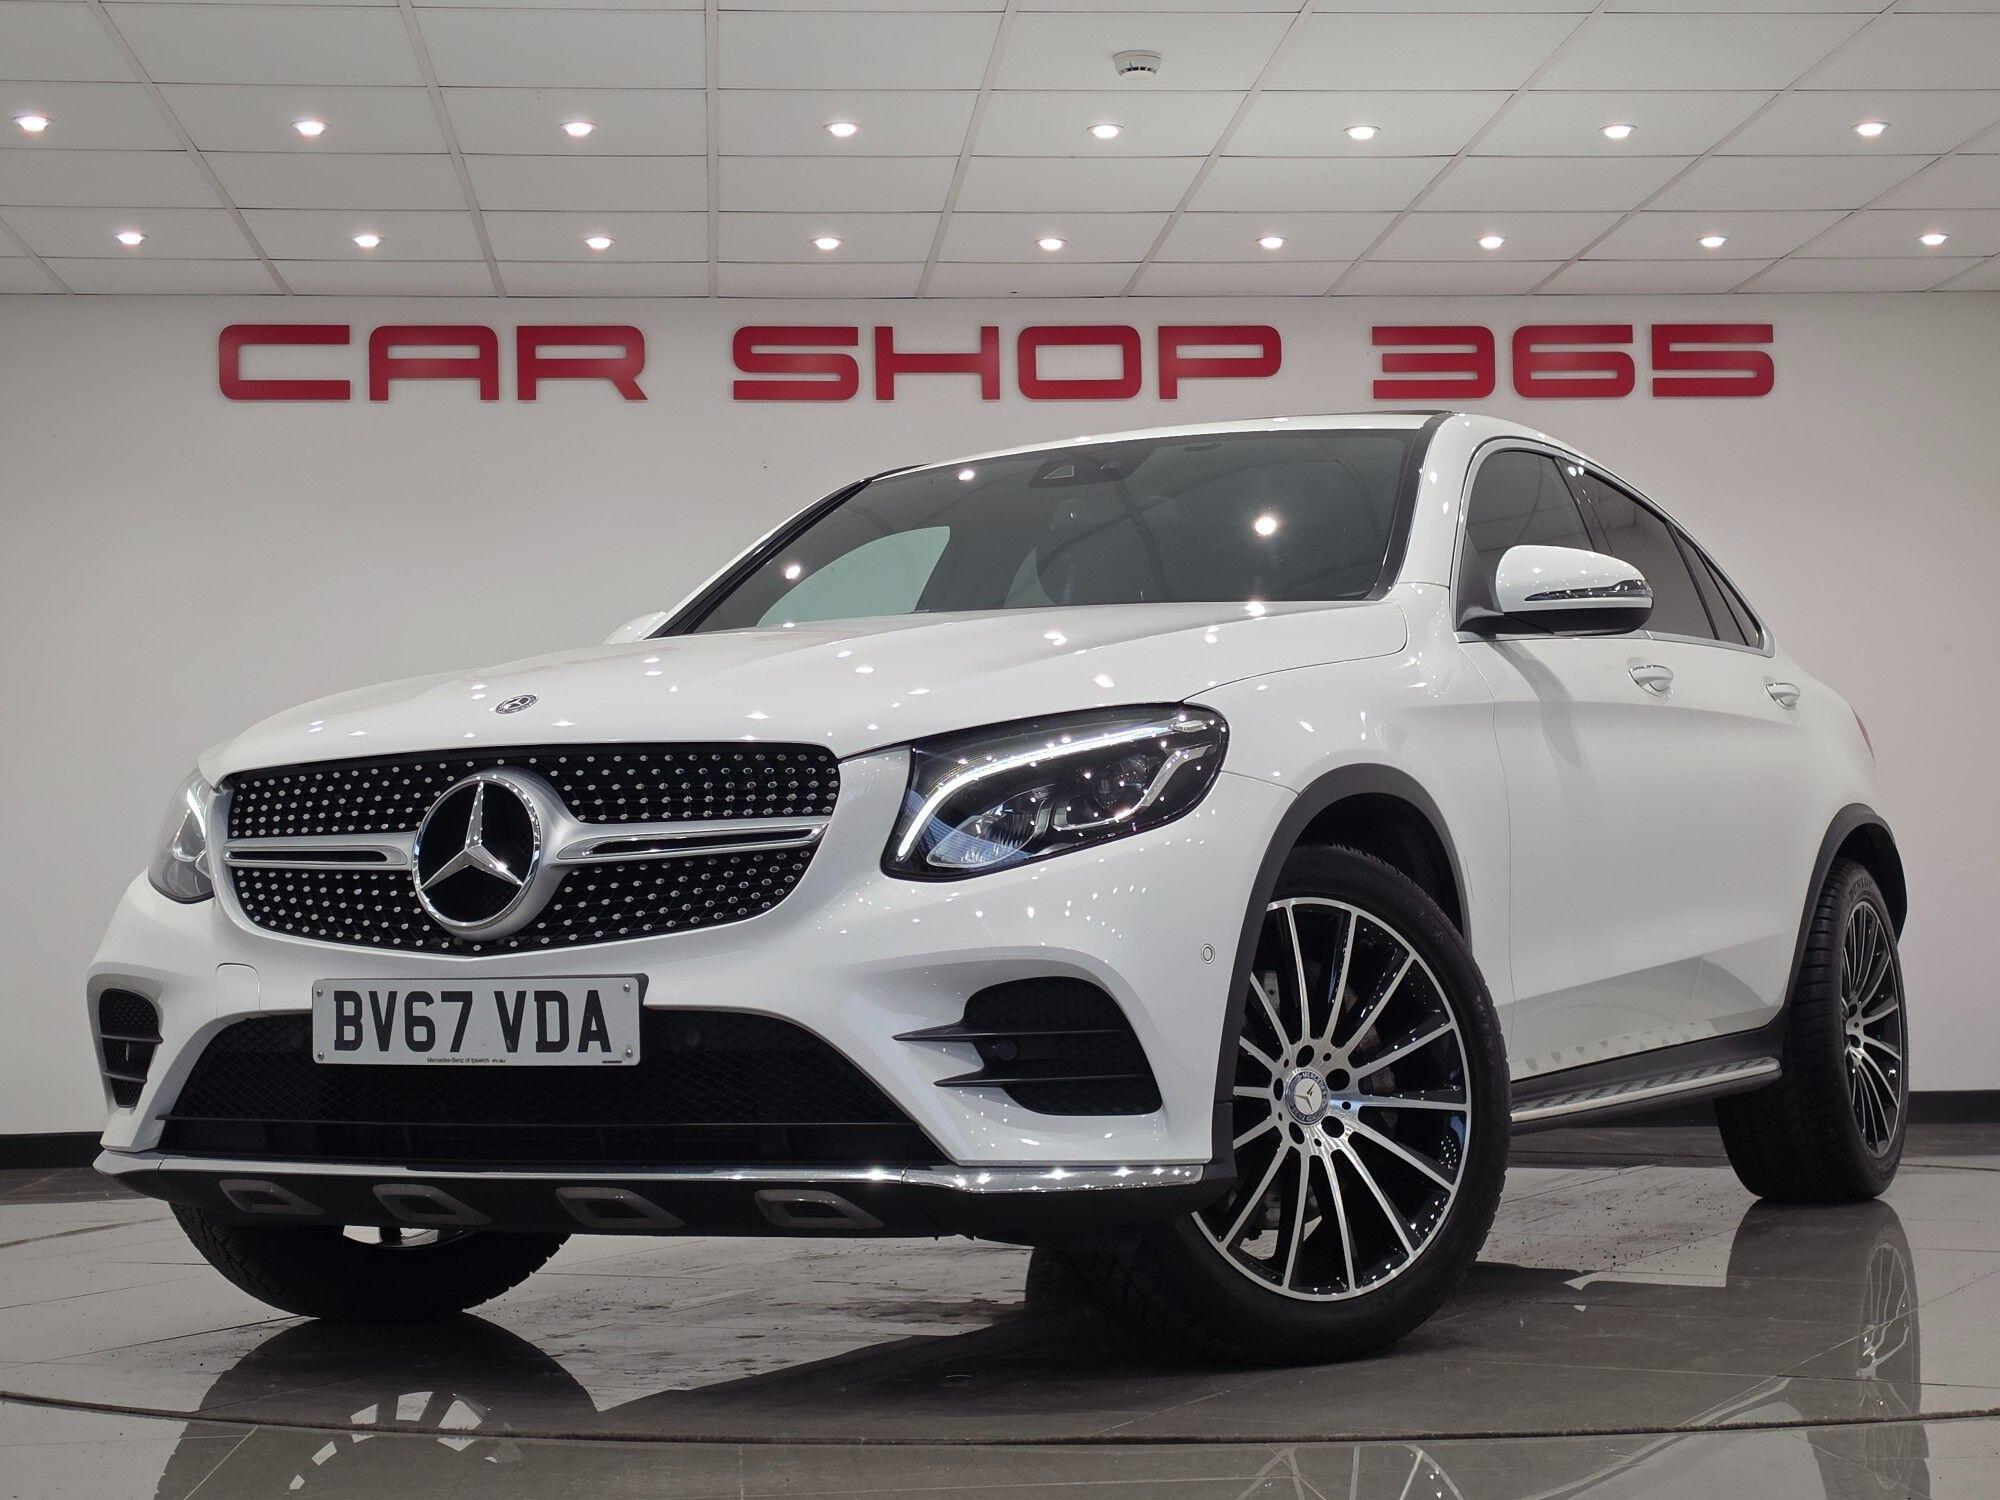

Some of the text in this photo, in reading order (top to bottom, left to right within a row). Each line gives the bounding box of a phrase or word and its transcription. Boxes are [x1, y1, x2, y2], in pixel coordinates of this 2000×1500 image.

[220, 325, 1774, 400] CAR SHOP 365
[333, 989, 613, 1053] BV67 VDA
